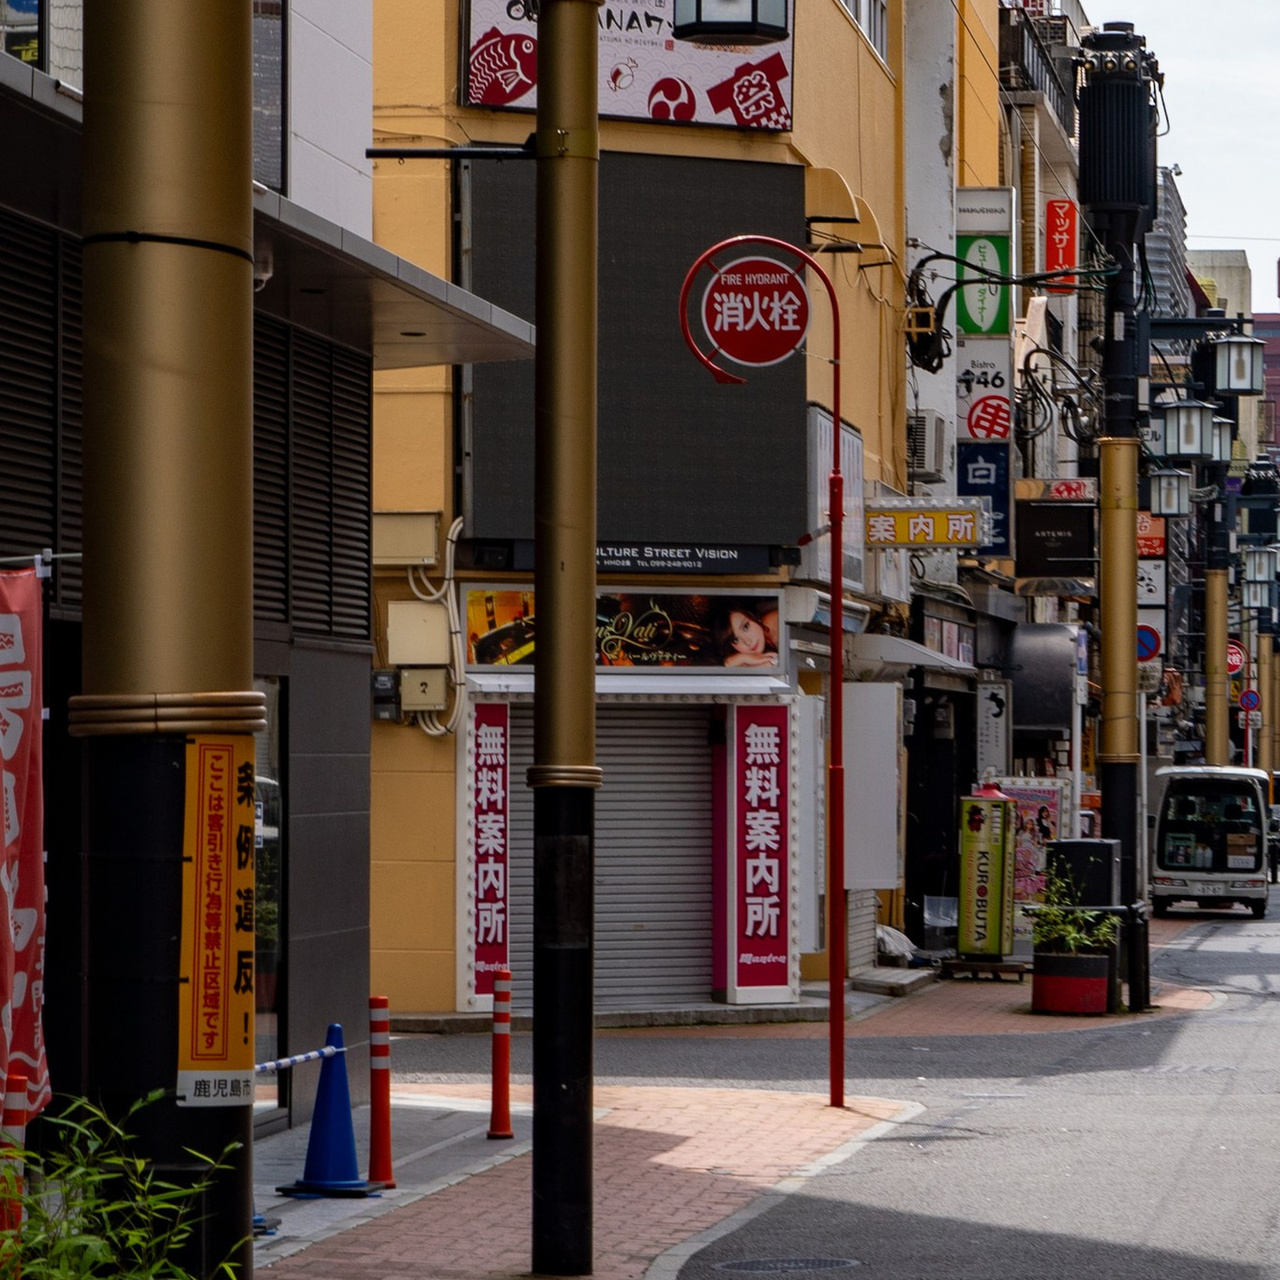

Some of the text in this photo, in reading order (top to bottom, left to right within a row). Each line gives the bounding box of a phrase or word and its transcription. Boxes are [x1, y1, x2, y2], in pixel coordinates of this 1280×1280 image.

[1052, 201, 1071, 281] マッサージ
[720, 273, 790, 286] FIRE HYDRANT
[713, 290, 802, 332] 消火栓
[970, 359, 996, 369] Bistro
[868, 513, 975, 542] 案内所
[1034, 530, 1073, 538] ARTEMIS
[644, 547, 692, 559] STREET
[695, 548, 738, 560] VISION
[476, 722, 506, 944] 無料案内所
[744, 722, 781, 937] 無料案内所
[203, 753, 226, 1050] ここは客引き行為等禁止区域です
[193, 1078, 253, 1099] 鹿児島市
